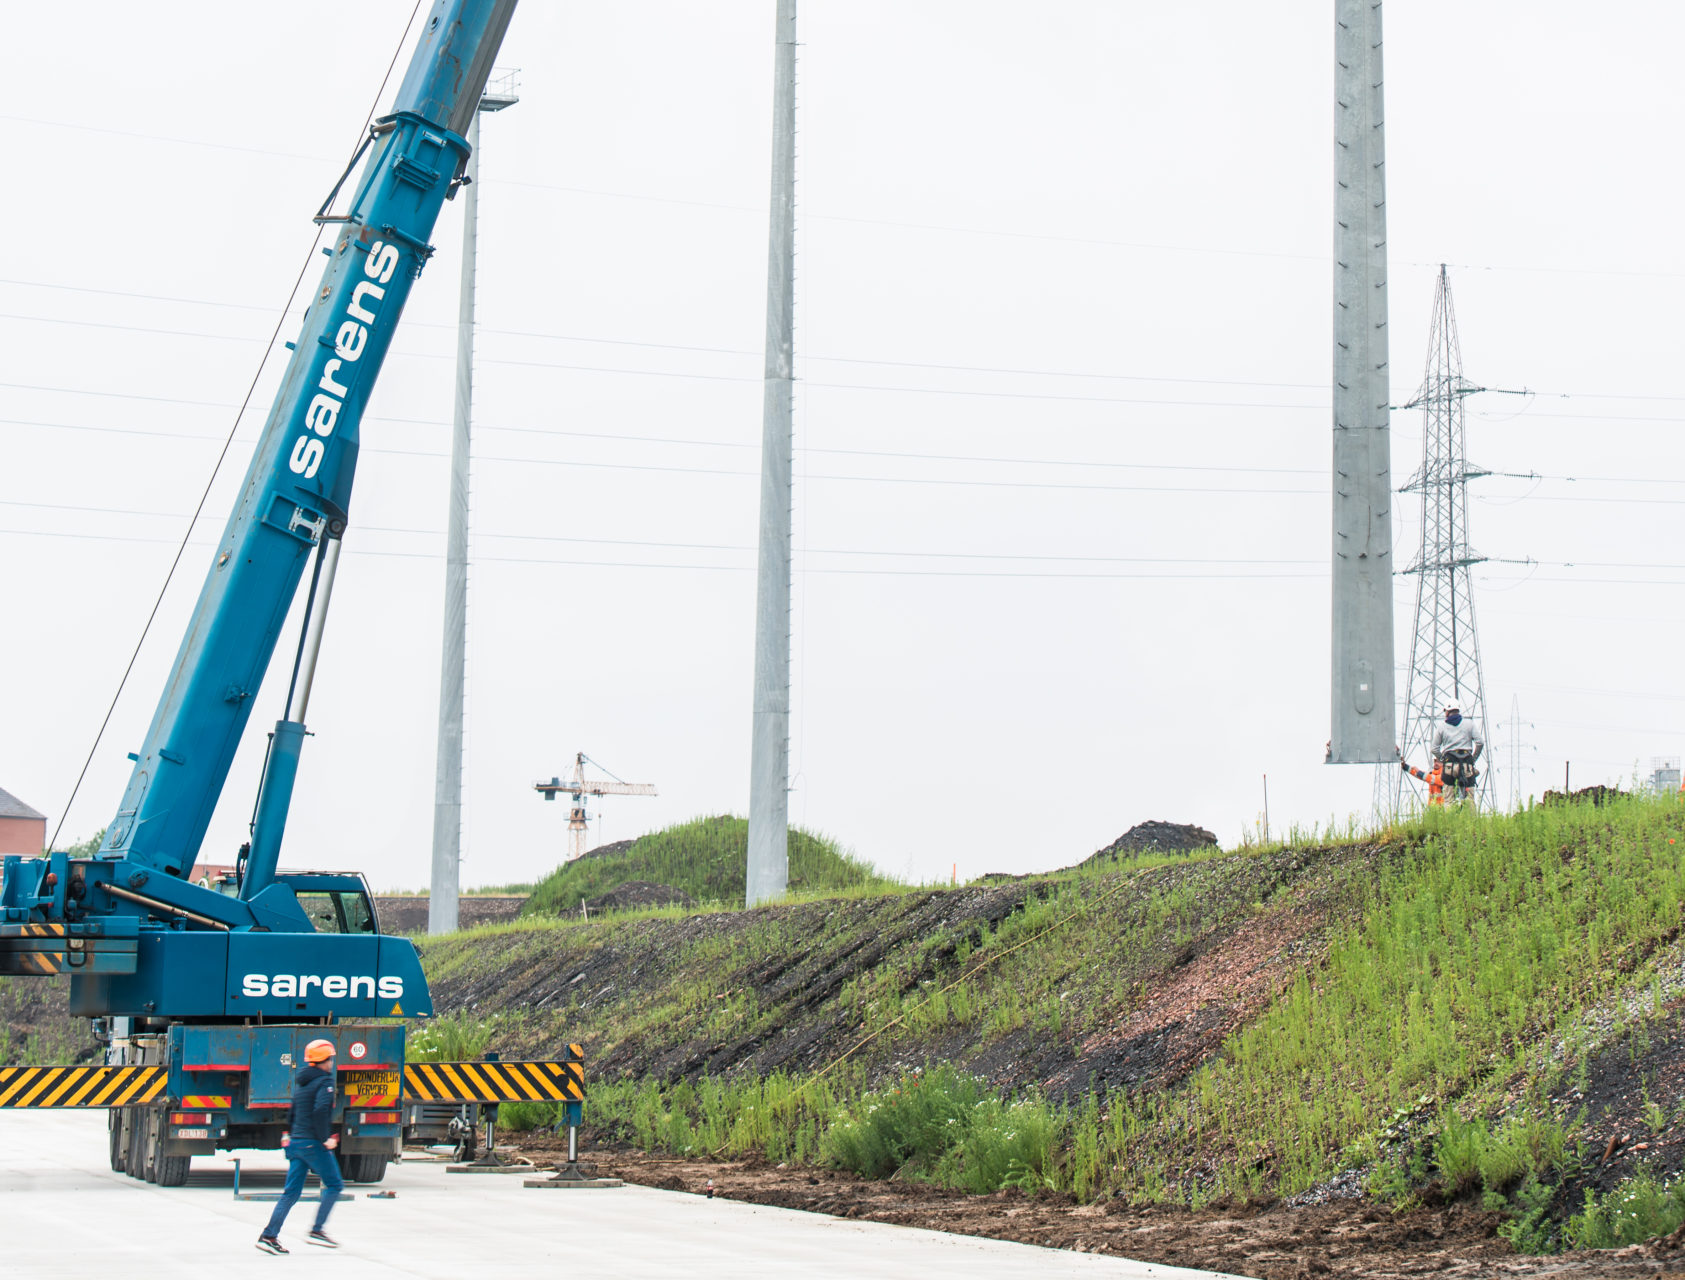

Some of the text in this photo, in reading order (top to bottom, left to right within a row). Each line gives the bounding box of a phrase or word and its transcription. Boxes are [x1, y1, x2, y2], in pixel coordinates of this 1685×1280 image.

[289, 240, 399, 479] sarens
[242, 974, 404, 999] sarens
[357, 1083, 388, 1096] VERVOER
